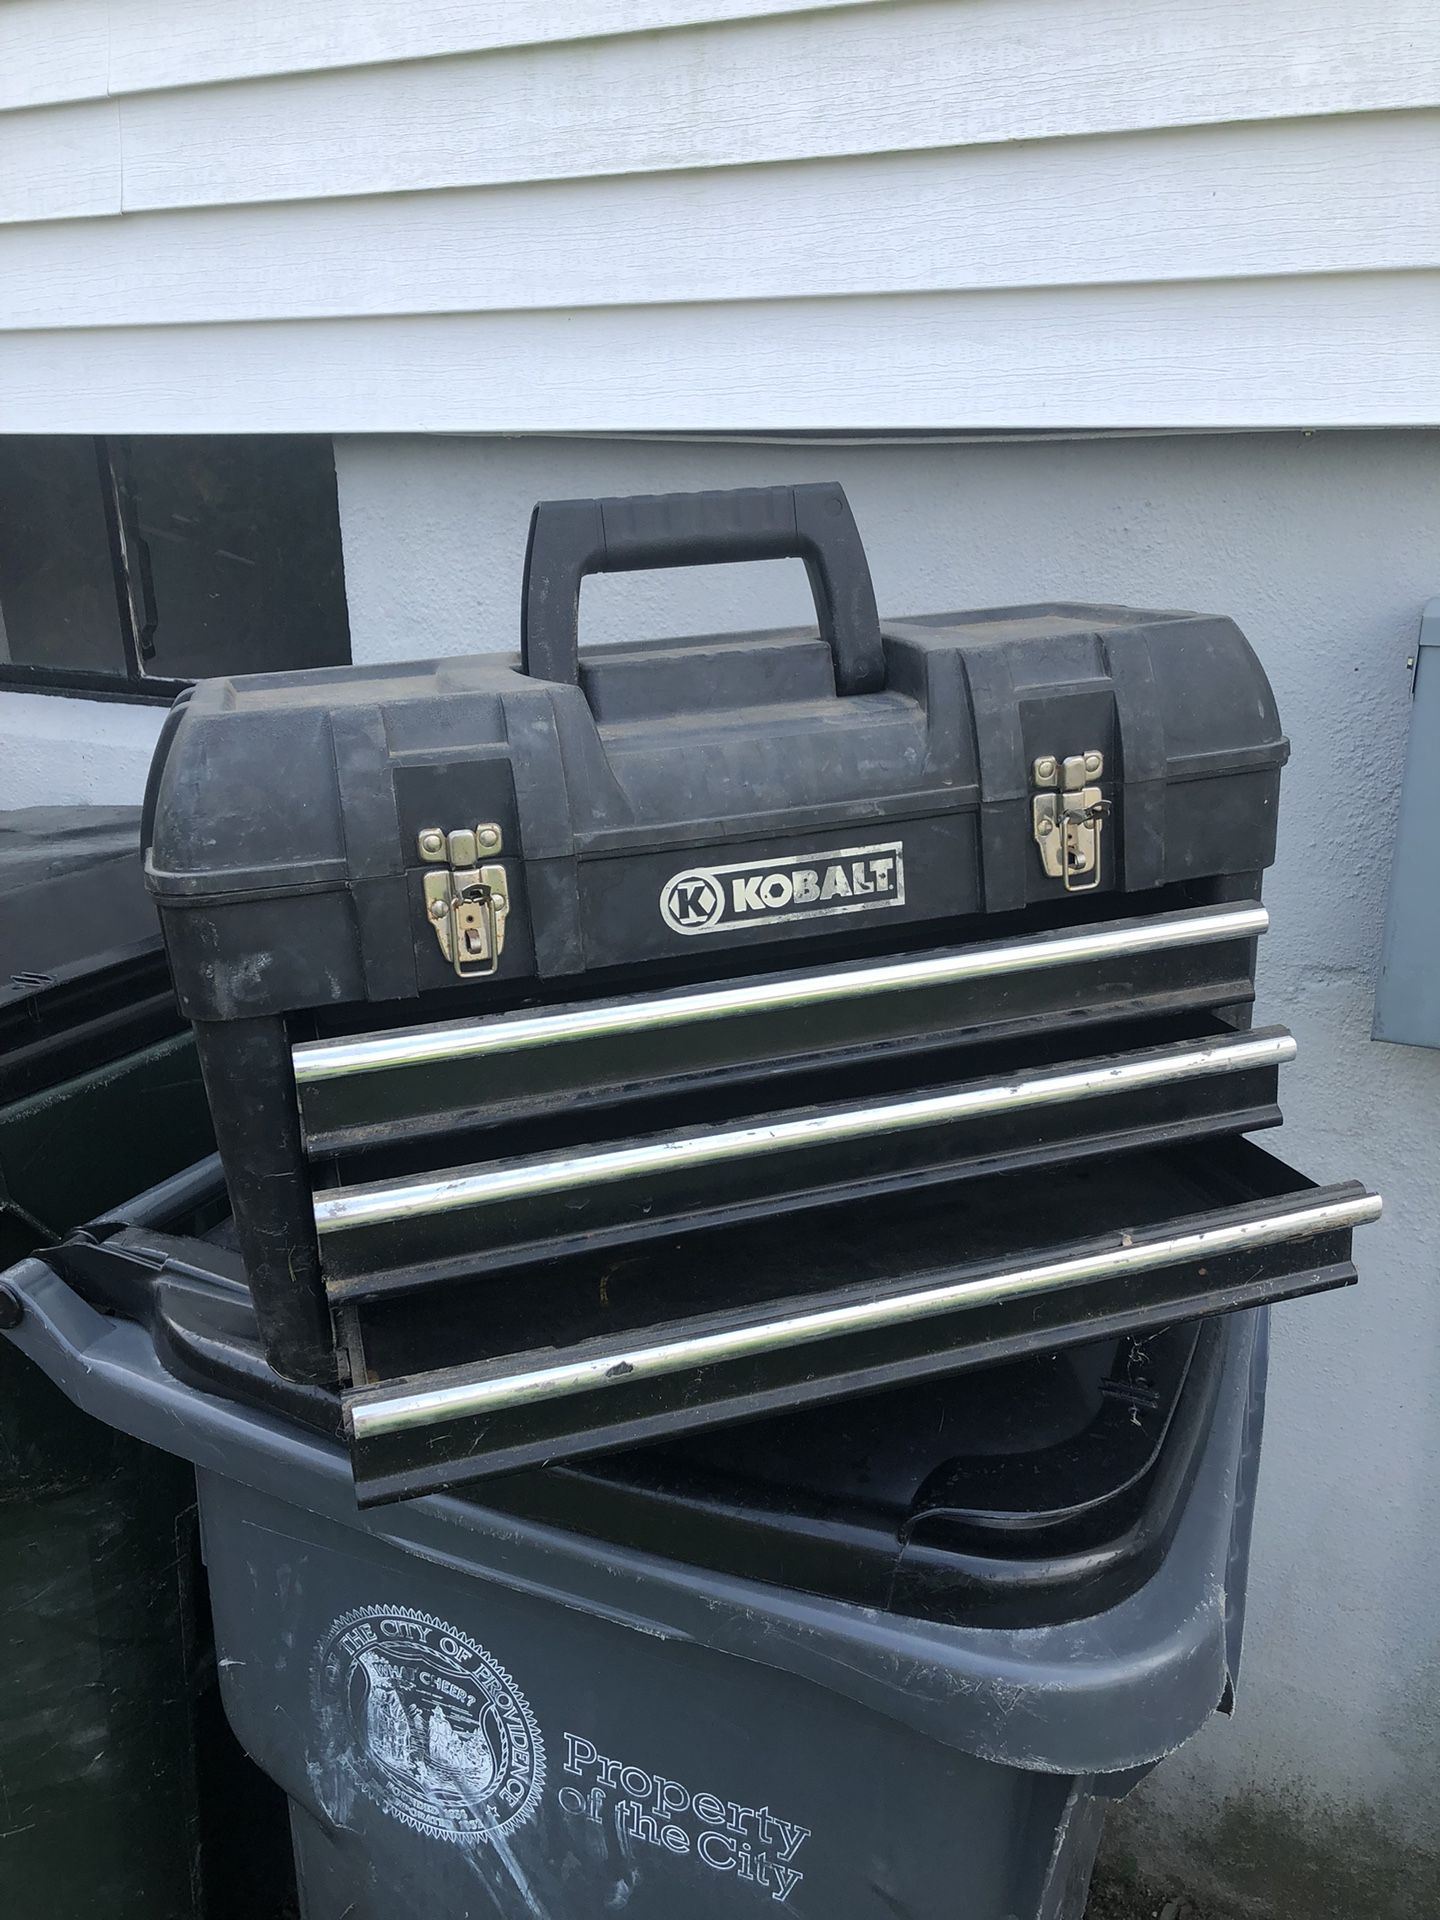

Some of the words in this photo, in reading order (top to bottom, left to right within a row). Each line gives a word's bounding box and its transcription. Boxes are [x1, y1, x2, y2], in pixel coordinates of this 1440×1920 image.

[732, 857, 894, 913] KOBALT
[336, 1622, 378, 1656] THE
[380, 1619, 433, 1644] CITY
[439, 1638, 473, 1663] OF
[474, 1662, 531, 1808] PROVIDENCE
[373, 1663, 420, 1681] WHAT
[419, 1671, 477, 1707] CHEER?
[561, 1732, 812, 1861] Property
[614, 1799, 691, 1857] the
[697, 1830, 804, 1902] City
